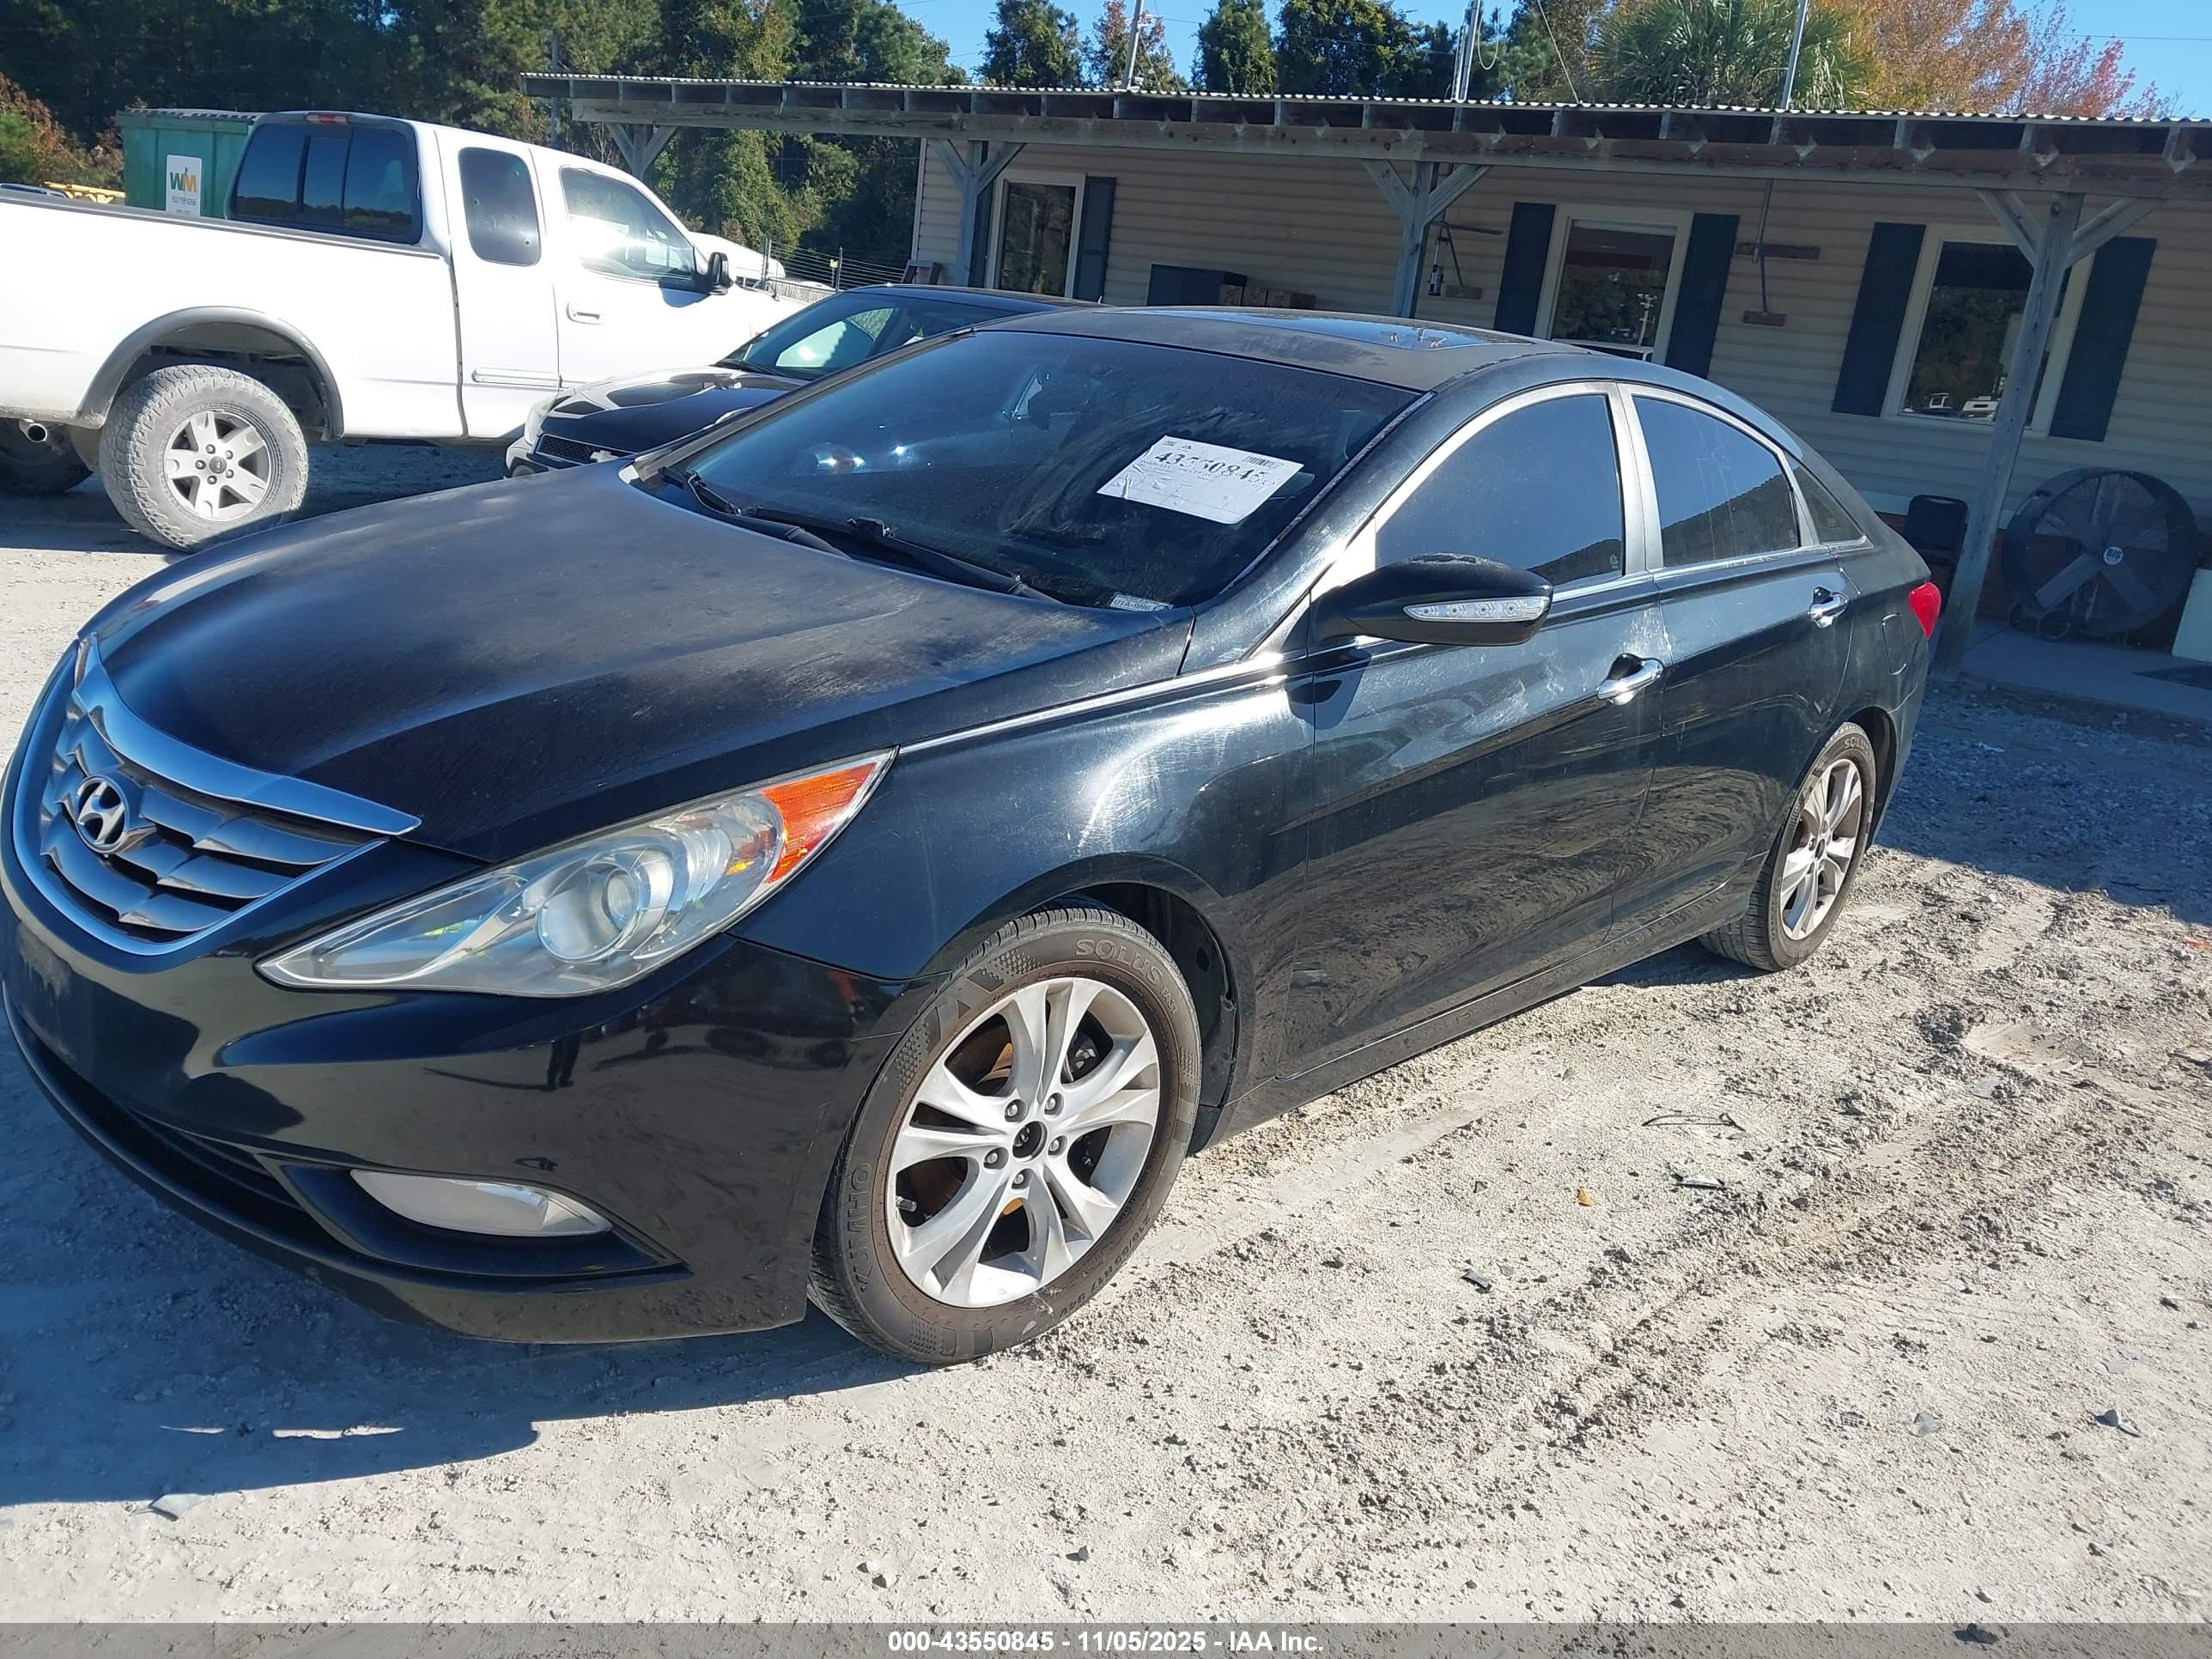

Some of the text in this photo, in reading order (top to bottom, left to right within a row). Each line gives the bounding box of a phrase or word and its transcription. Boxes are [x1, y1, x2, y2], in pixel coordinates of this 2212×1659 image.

[170, 172, 197, 193] WM
[1075, 939, 1163, 987] SOLUS
[847, 1163, 872, 1293] KUMHO
